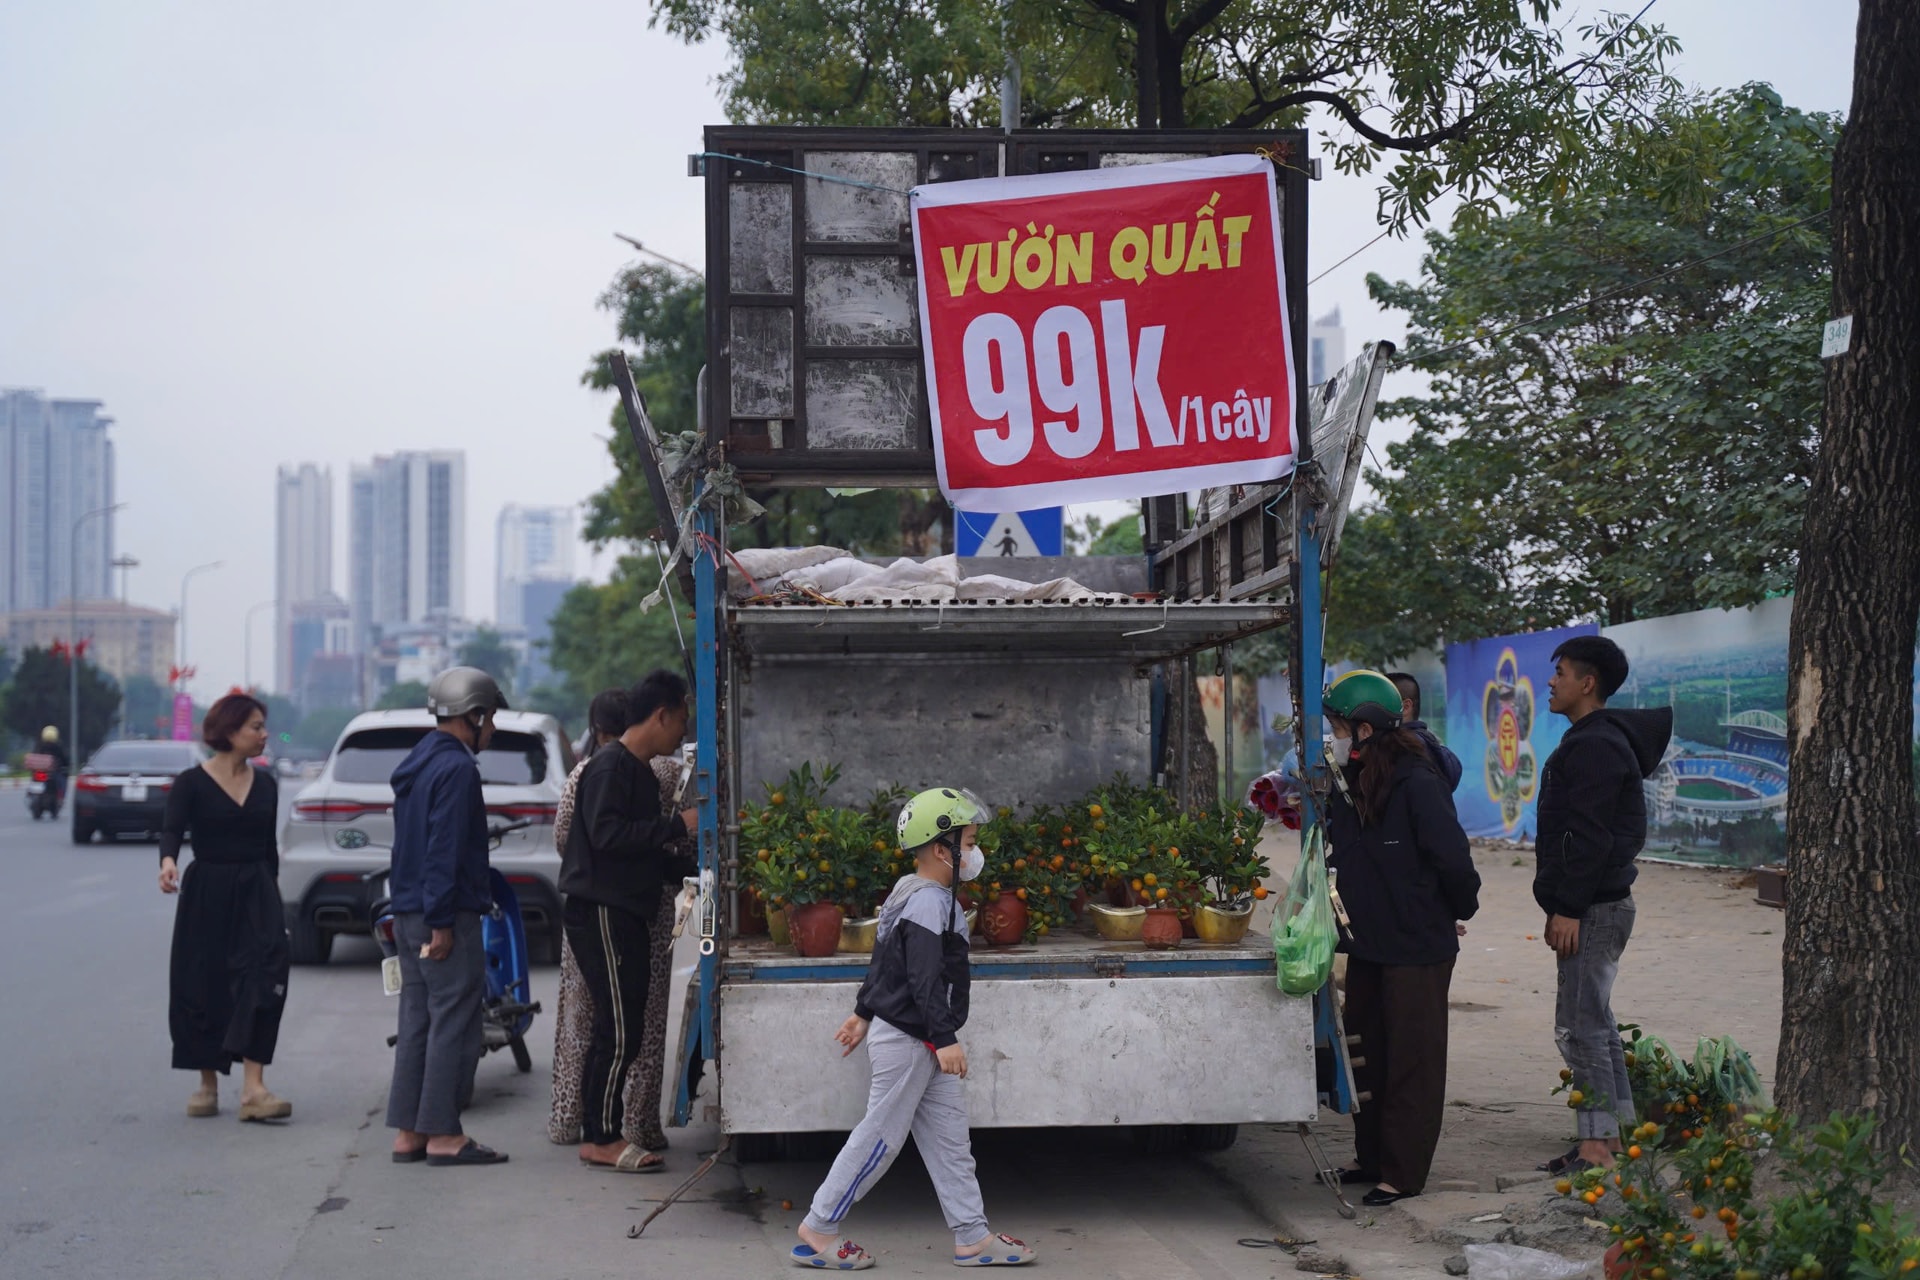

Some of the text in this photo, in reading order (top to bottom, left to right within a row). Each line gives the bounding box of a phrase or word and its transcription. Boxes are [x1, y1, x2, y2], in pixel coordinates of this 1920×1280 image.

[940, 191, 1252, 297] VƯỜN QUẤT
[1828, 322, 1848, 342] 349
